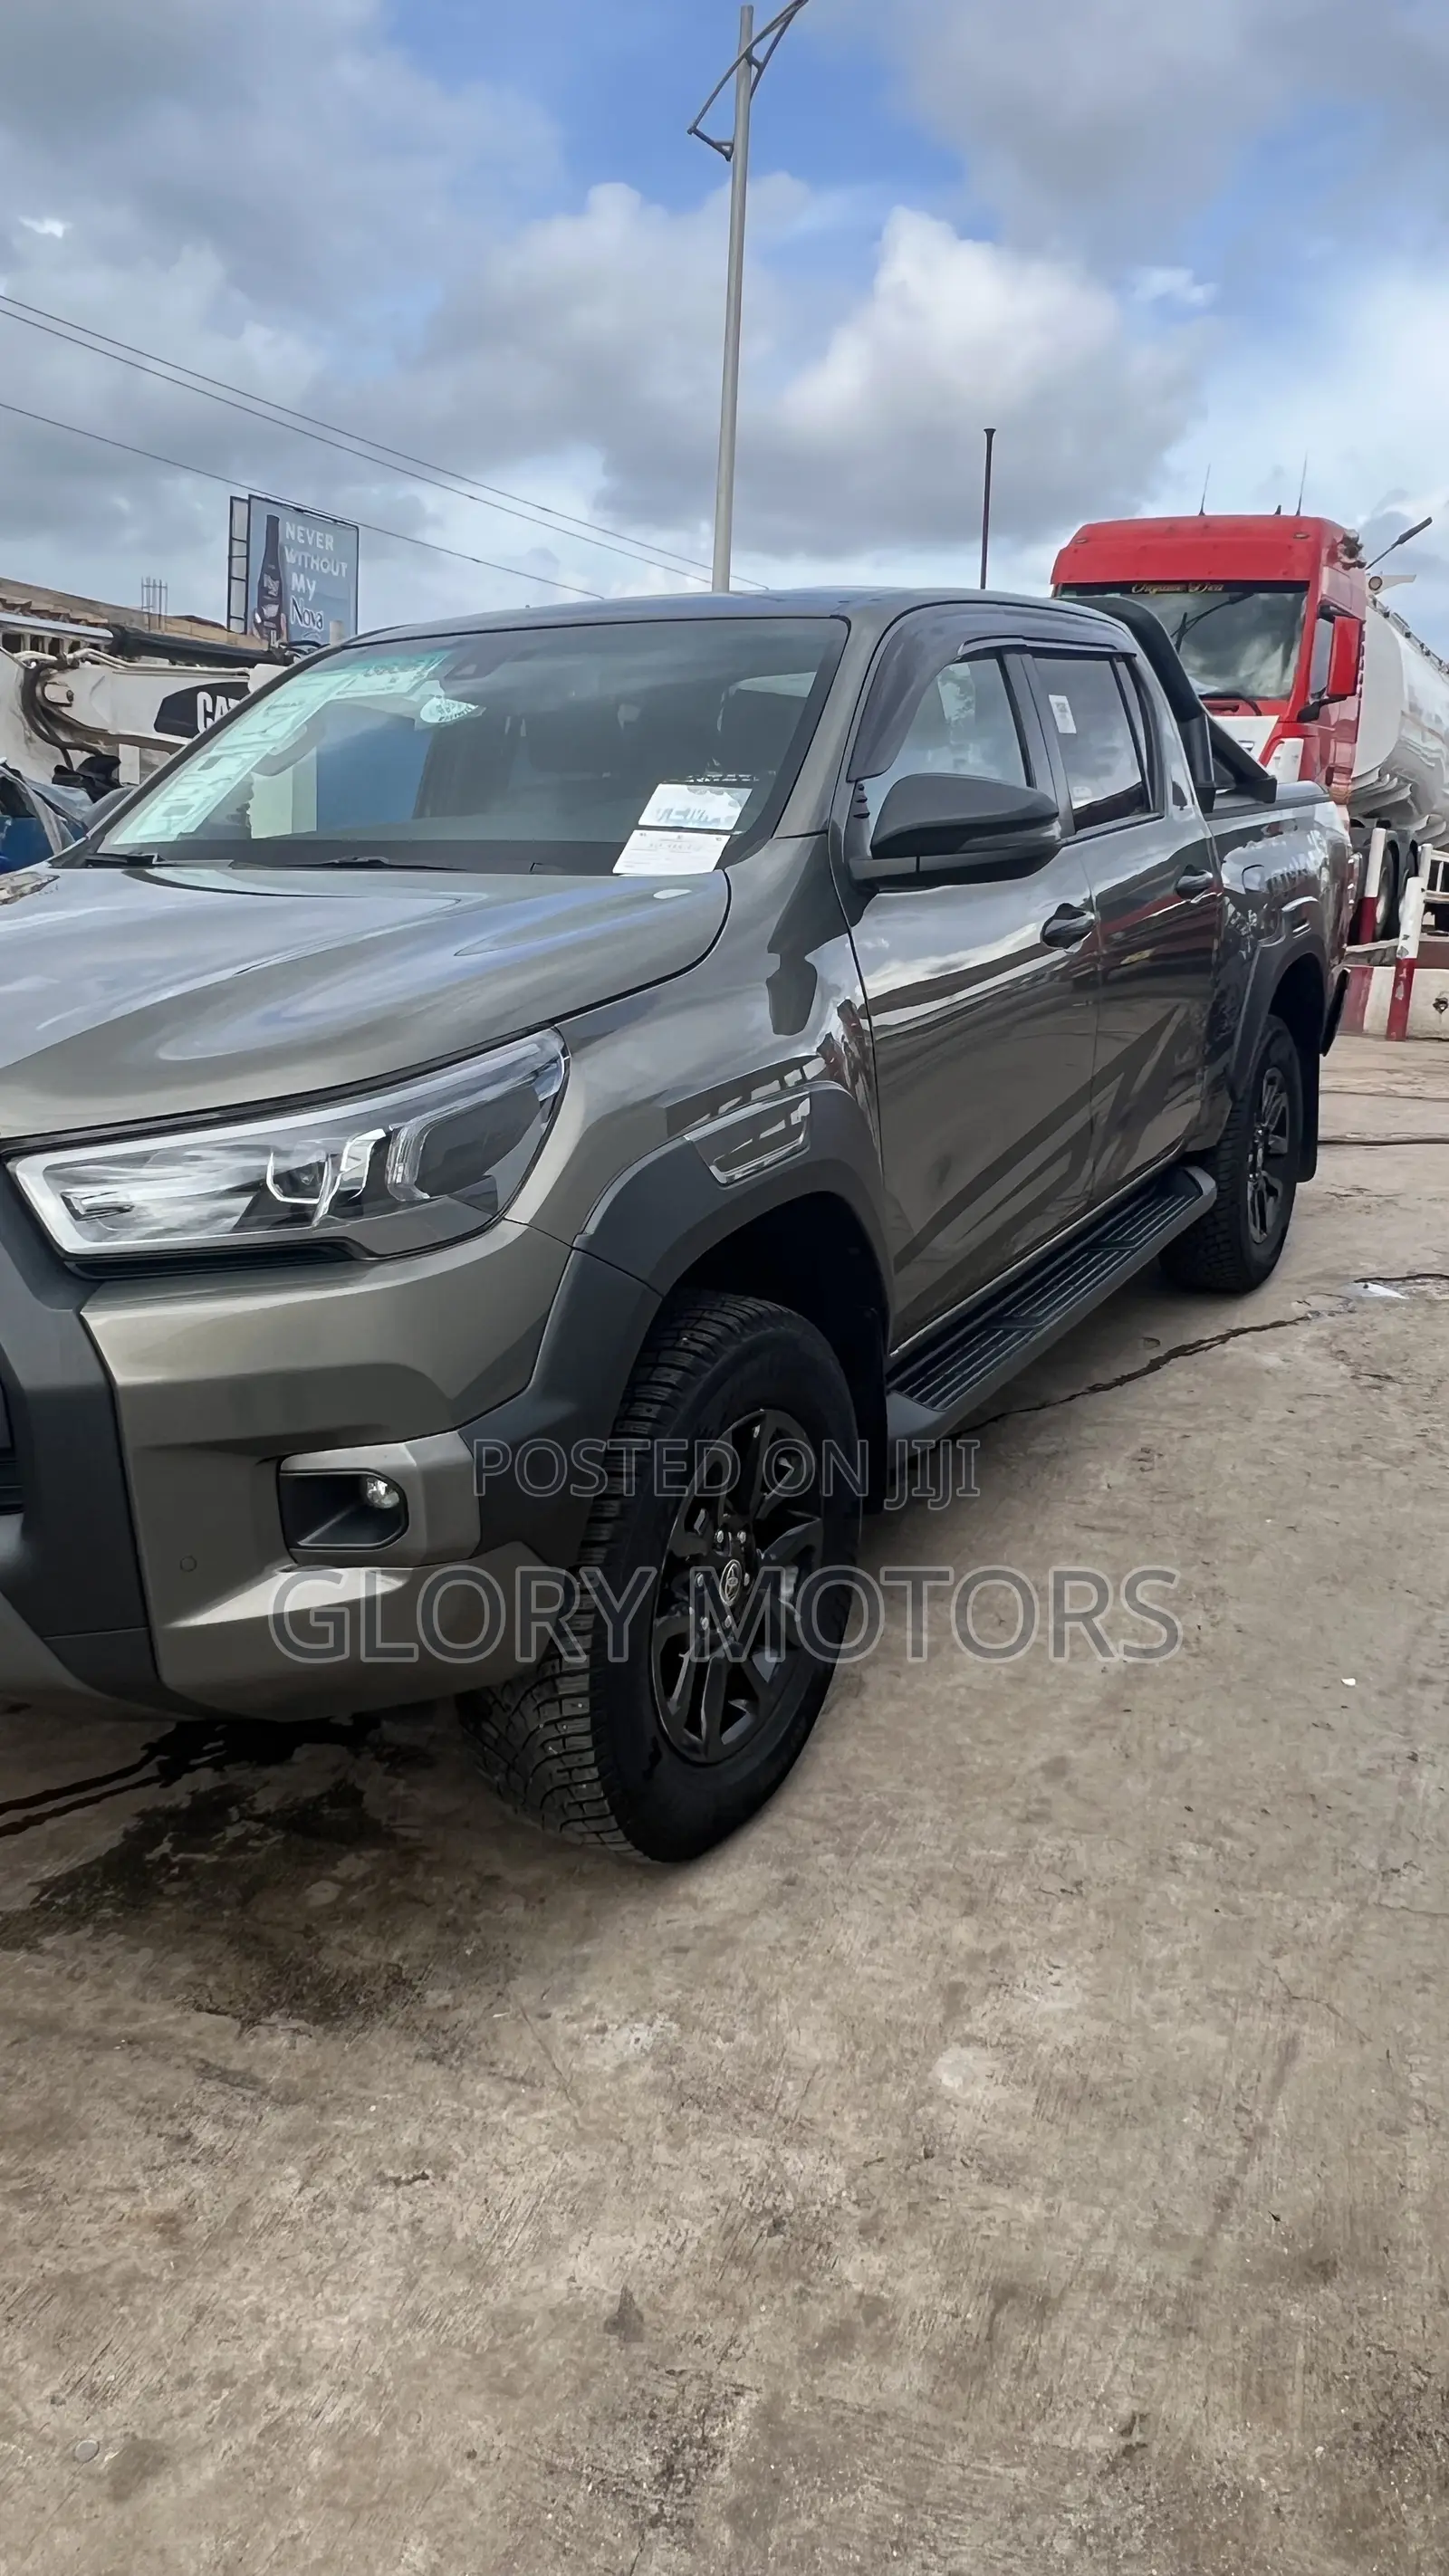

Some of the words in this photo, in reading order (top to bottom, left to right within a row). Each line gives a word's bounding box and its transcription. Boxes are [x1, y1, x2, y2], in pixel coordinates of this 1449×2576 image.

[285, 522, 334, 551] NEVER
[284, 545, 348, 578] WITHOUT
[290, 595, 323, 632] Nova
